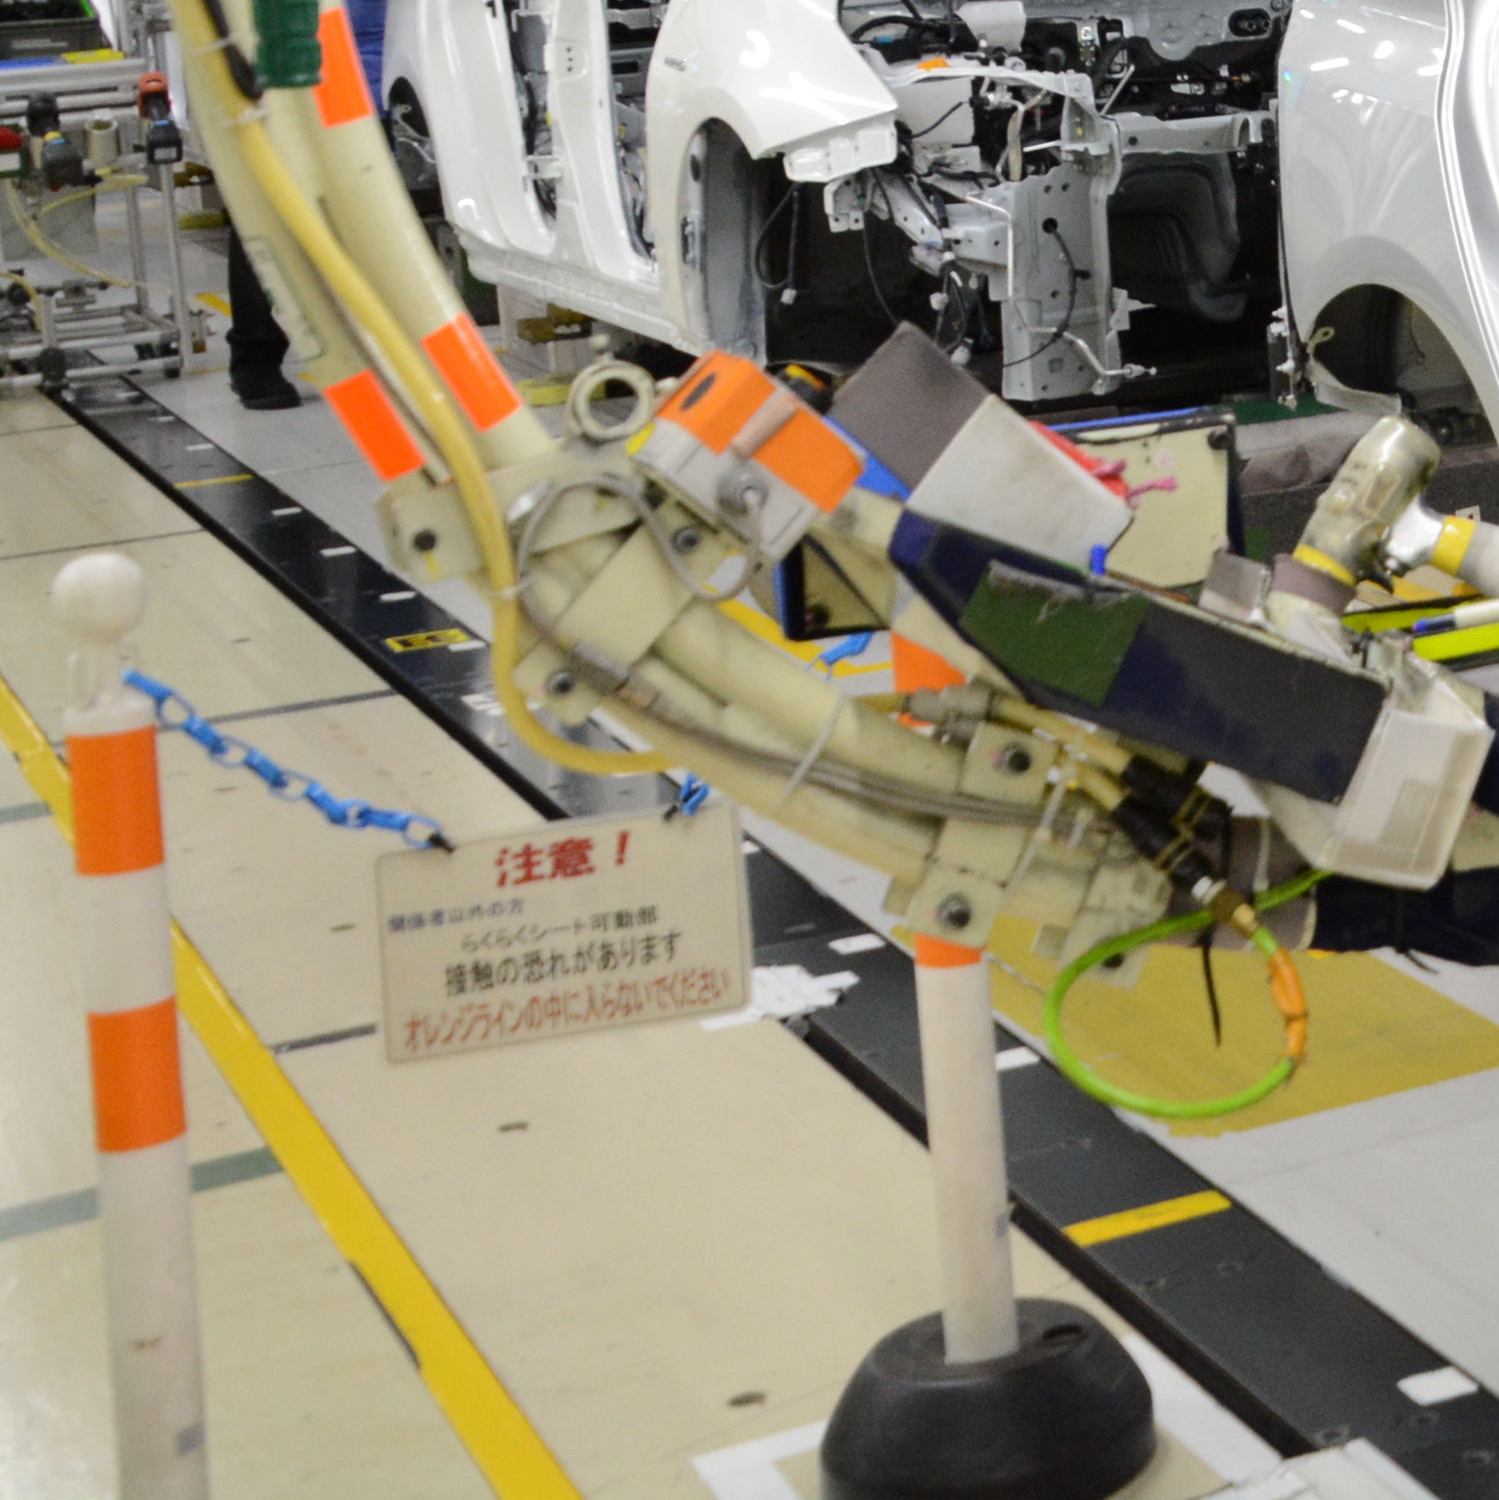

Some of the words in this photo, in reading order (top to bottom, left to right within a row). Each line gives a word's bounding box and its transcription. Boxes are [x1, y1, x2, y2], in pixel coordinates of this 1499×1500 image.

[445, 929, 682, 997] 接触の恐れがあります
[404, 967, 731, 1052] オレンジラインの中に入らないでください
